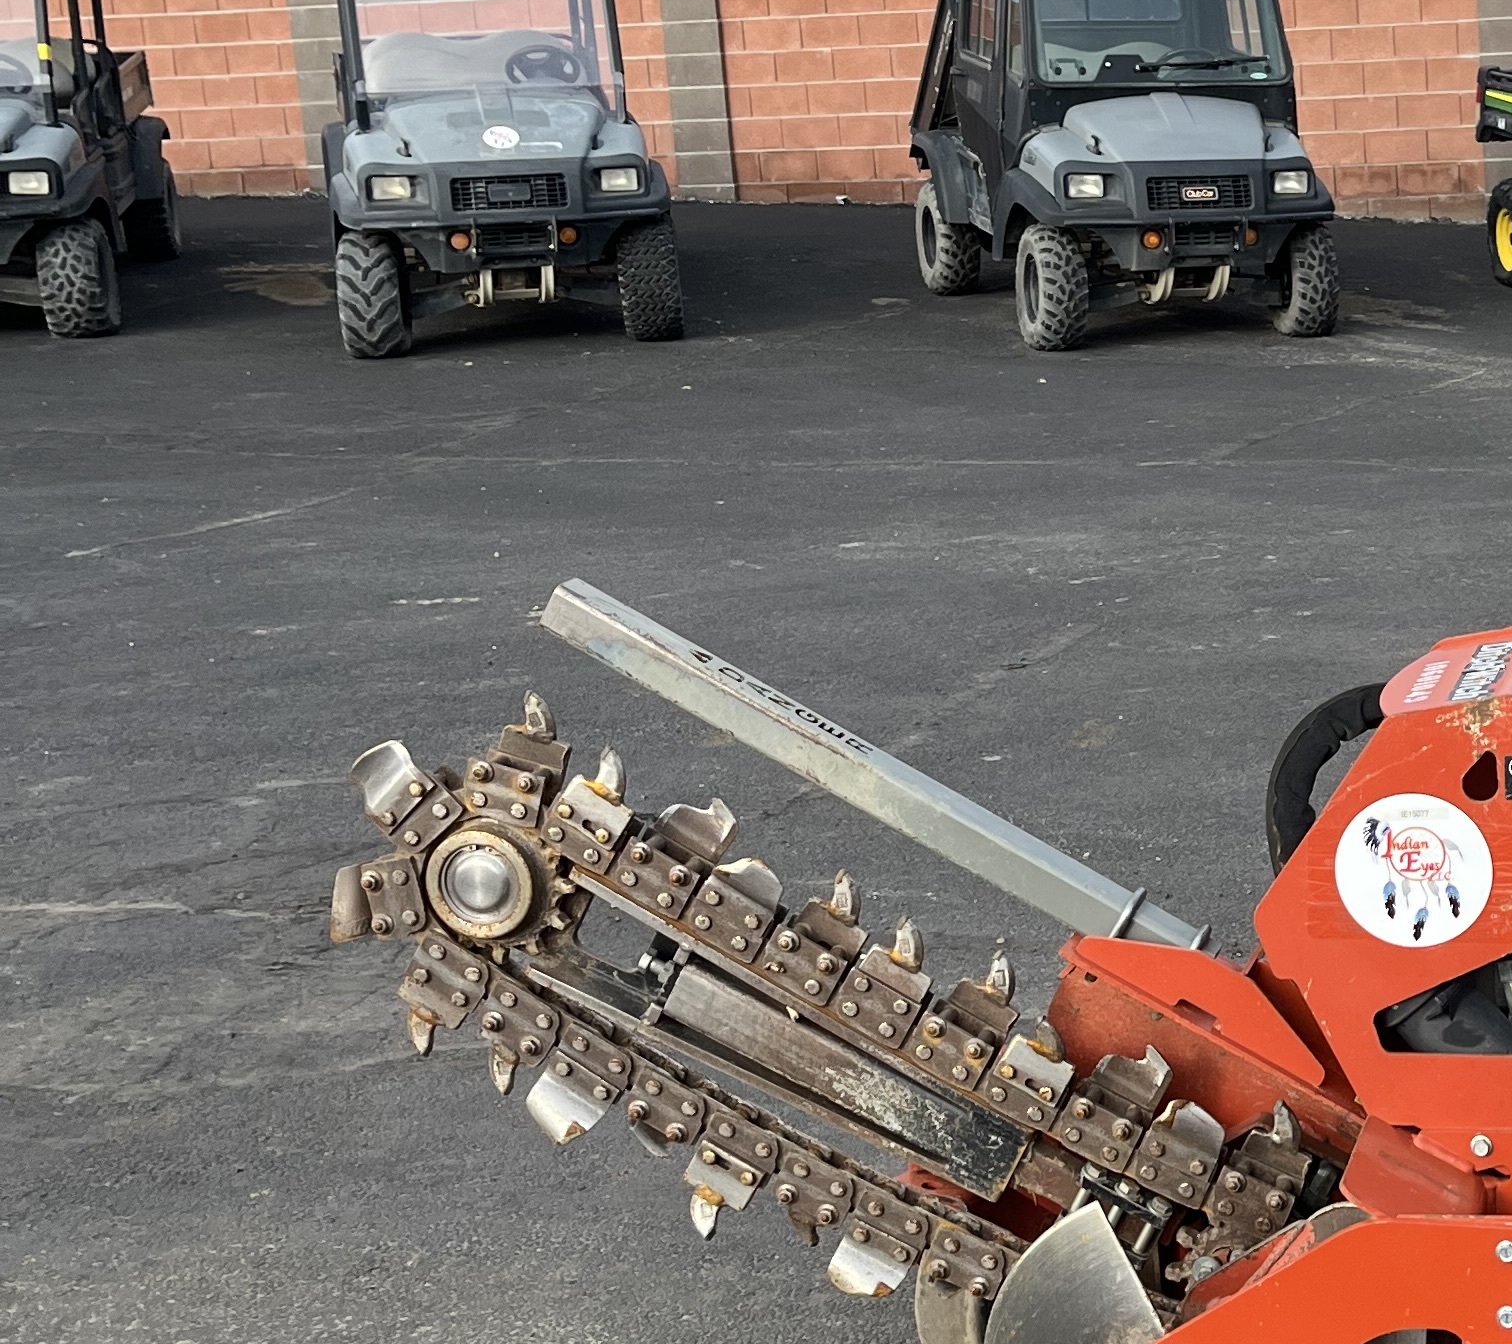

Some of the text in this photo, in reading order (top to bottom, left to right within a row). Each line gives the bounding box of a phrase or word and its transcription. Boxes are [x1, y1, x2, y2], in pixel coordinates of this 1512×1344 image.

[718, 666, 875, 755] DANGER
[1381, 830, 1429, 859] Indian
[1400, 851, 1441, 876] Eyes
